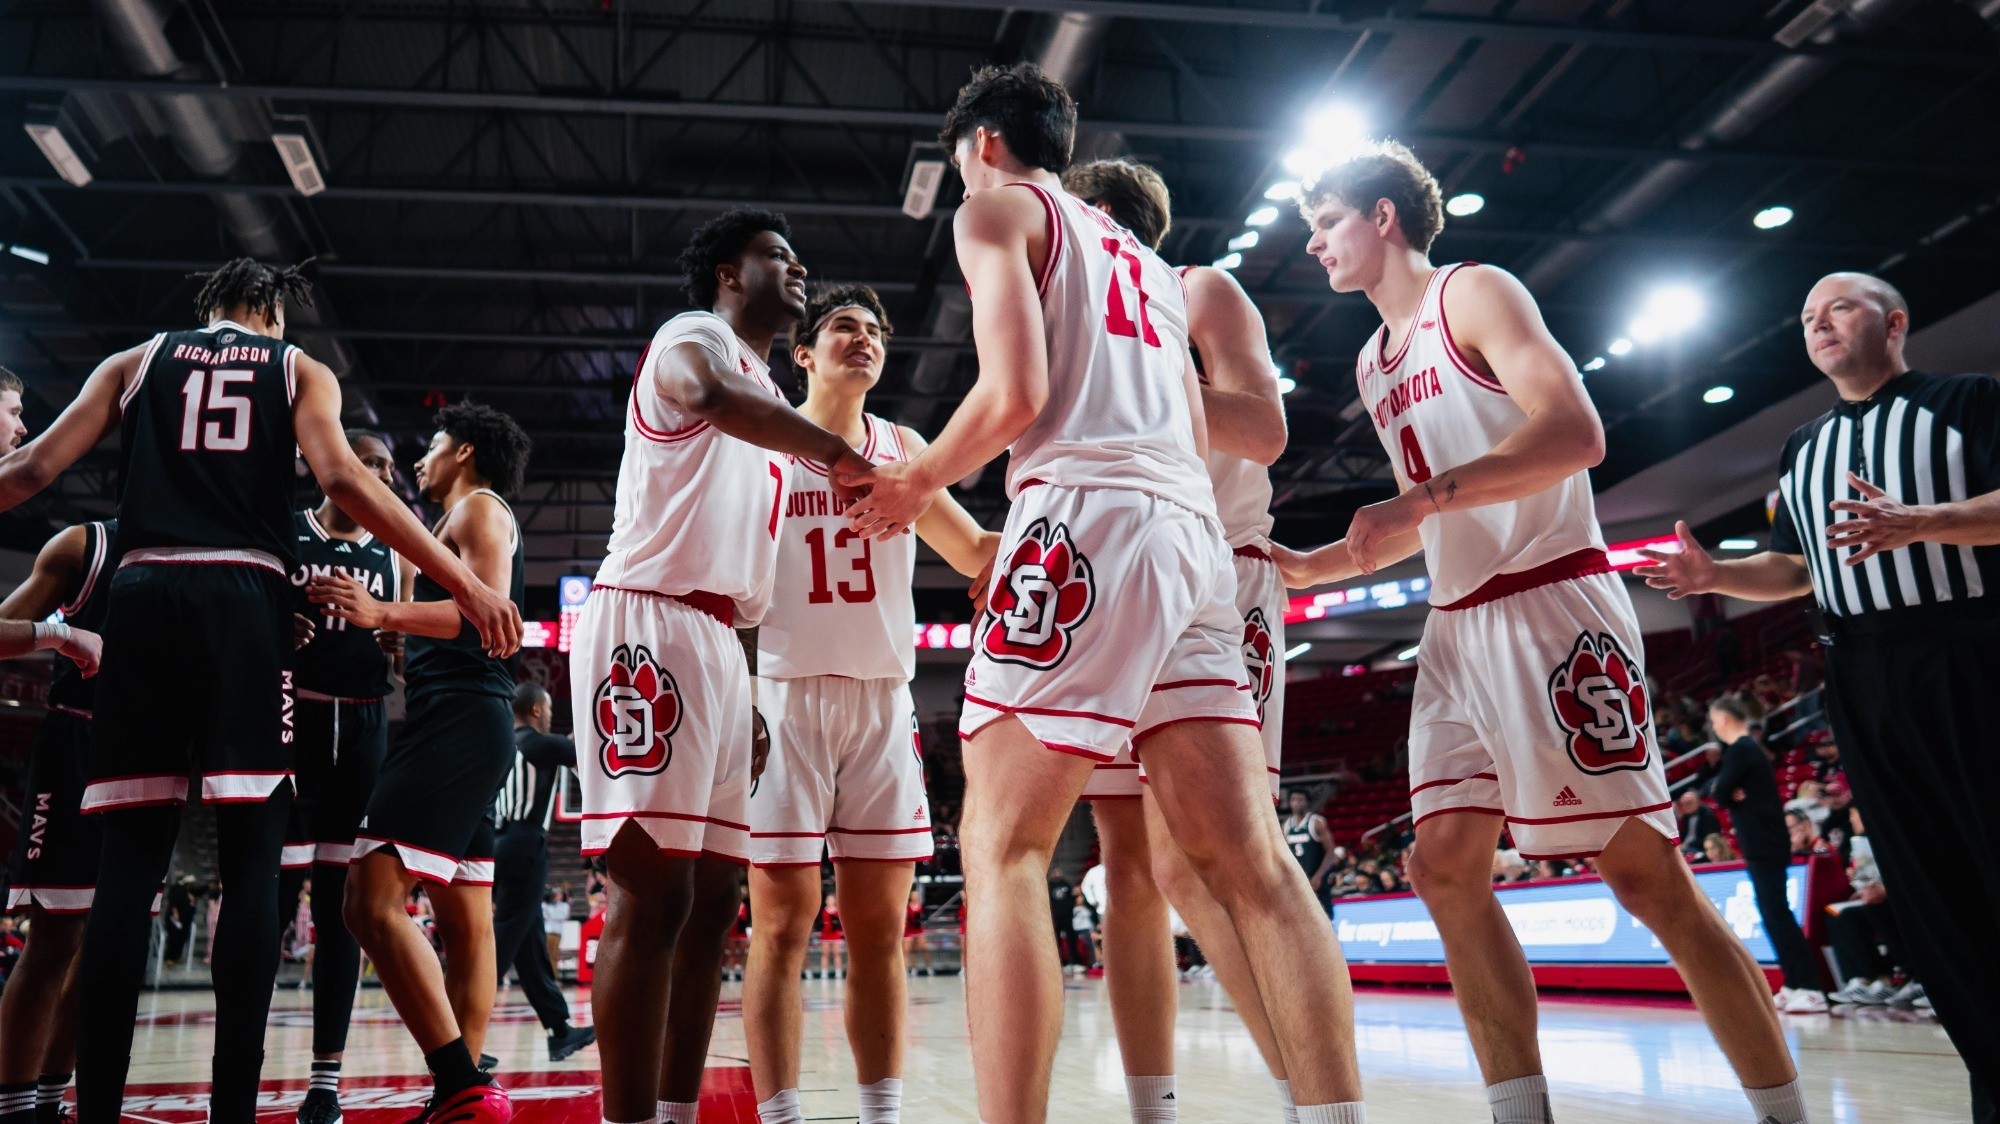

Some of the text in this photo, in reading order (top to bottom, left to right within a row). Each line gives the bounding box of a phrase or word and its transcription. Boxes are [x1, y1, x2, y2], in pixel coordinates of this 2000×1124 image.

[1101, 236, 1162, 348] 11
[173, 344, 270, 365] RICHARDSON
[180, 369, 256, 452] 15
[785, 490, 828, 518] OUTH
[804, 527, 877, 604] 13
[281, 670, 294, 744] MAVS
[27, 792, 52, 860] MAVS
[1553, 798, 1582, 806] adidas
